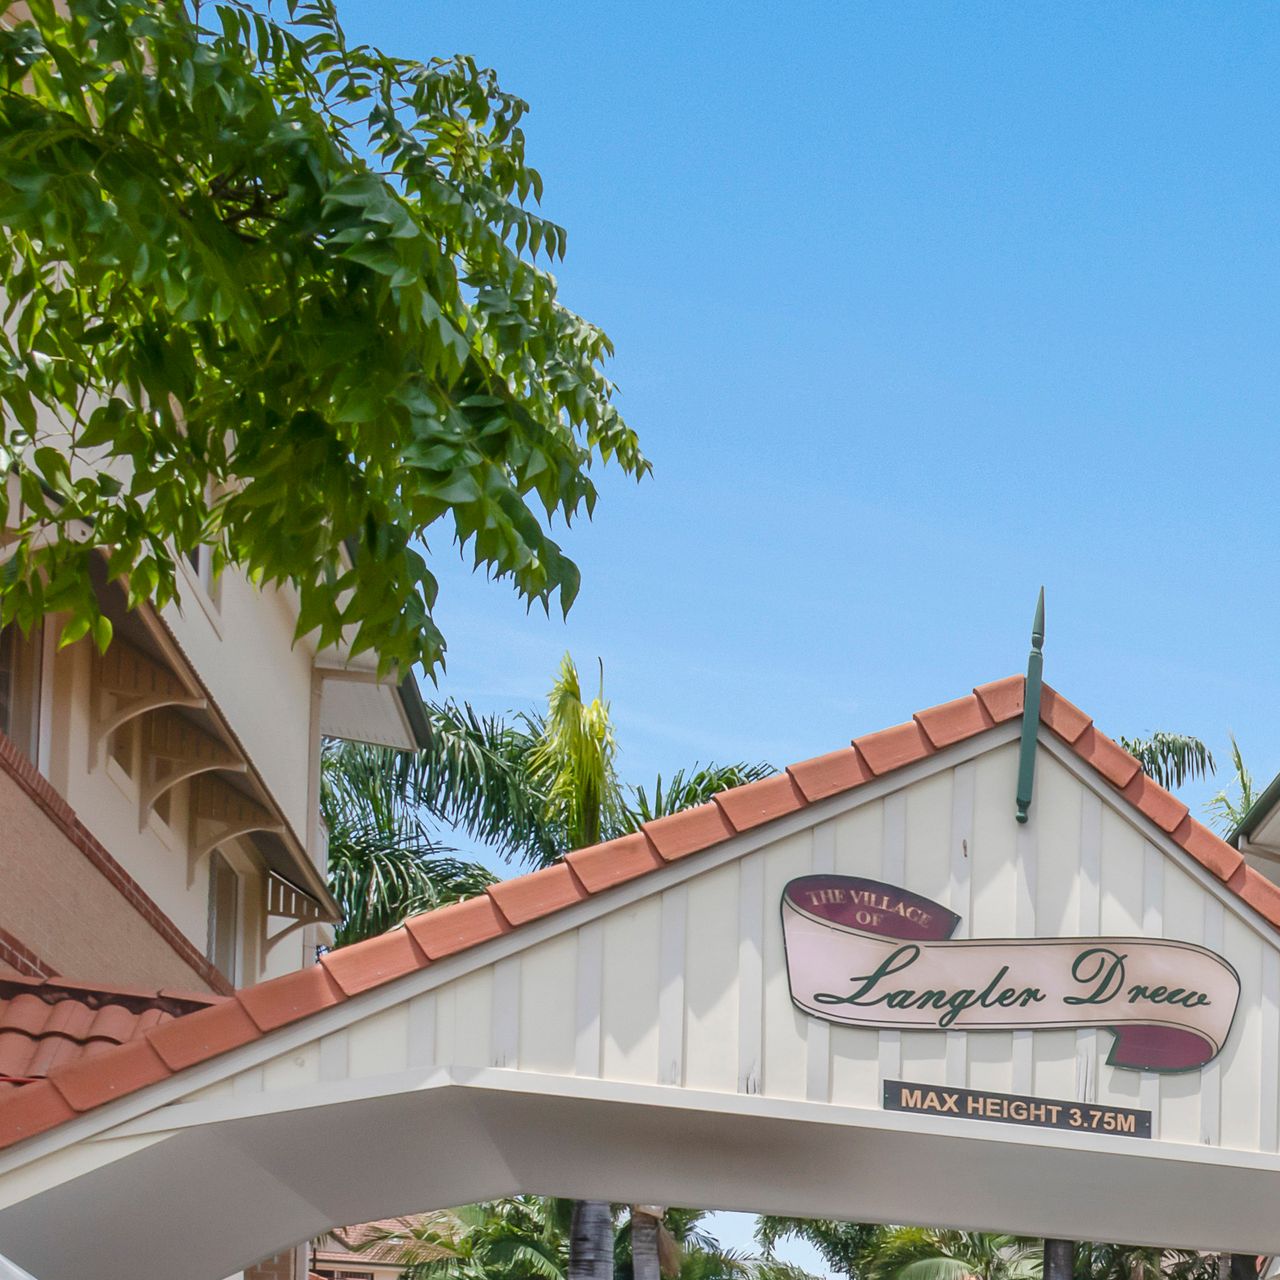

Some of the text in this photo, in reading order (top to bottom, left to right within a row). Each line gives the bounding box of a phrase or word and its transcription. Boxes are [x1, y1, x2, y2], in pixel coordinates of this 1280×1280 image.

[806, 889, 932, 928] THE VILLAGE
[855, 910, 884, 926] OF
[813, 943, 1211, 1028] Langler Drew
[901, 1088, 1136, 1133] MAX HEIGHT 3.75M
